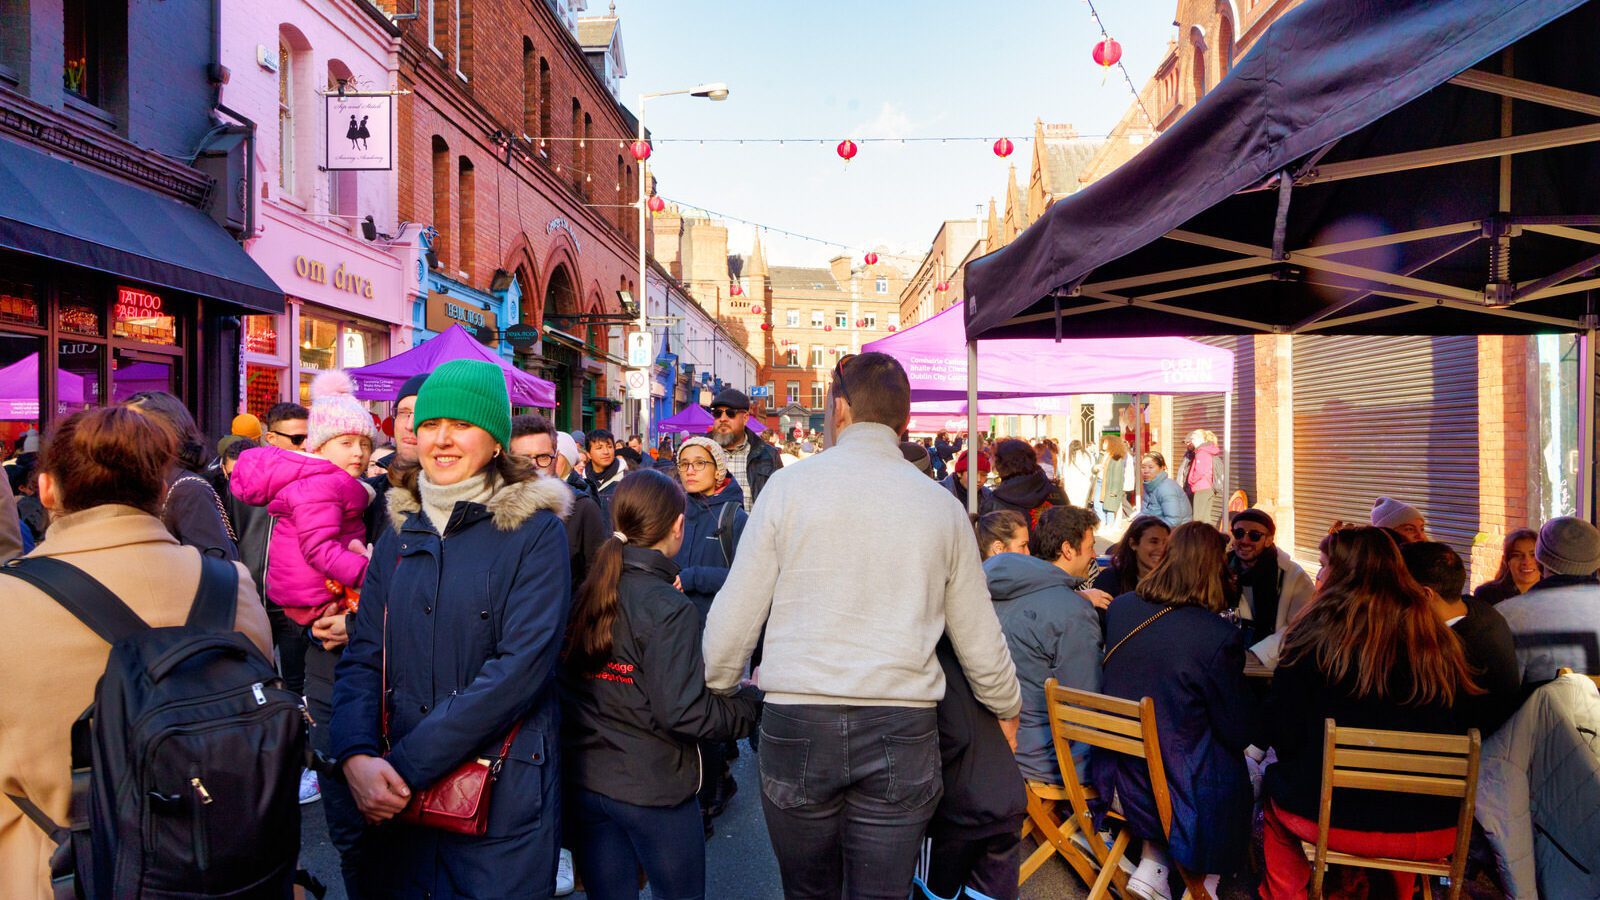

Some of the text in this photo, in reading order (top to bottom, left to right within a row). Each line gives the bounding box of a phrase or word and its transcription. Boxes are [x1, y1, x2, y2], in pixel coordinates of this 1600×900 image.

[296, 255, 375, 300] om diva
[119, 289, 161, 310] TATTOO
[1160, 358, 1213, 371] DUBLIN
[933, 373, 946, 382] City
[1160, 371, 1213, 383] TOWN
